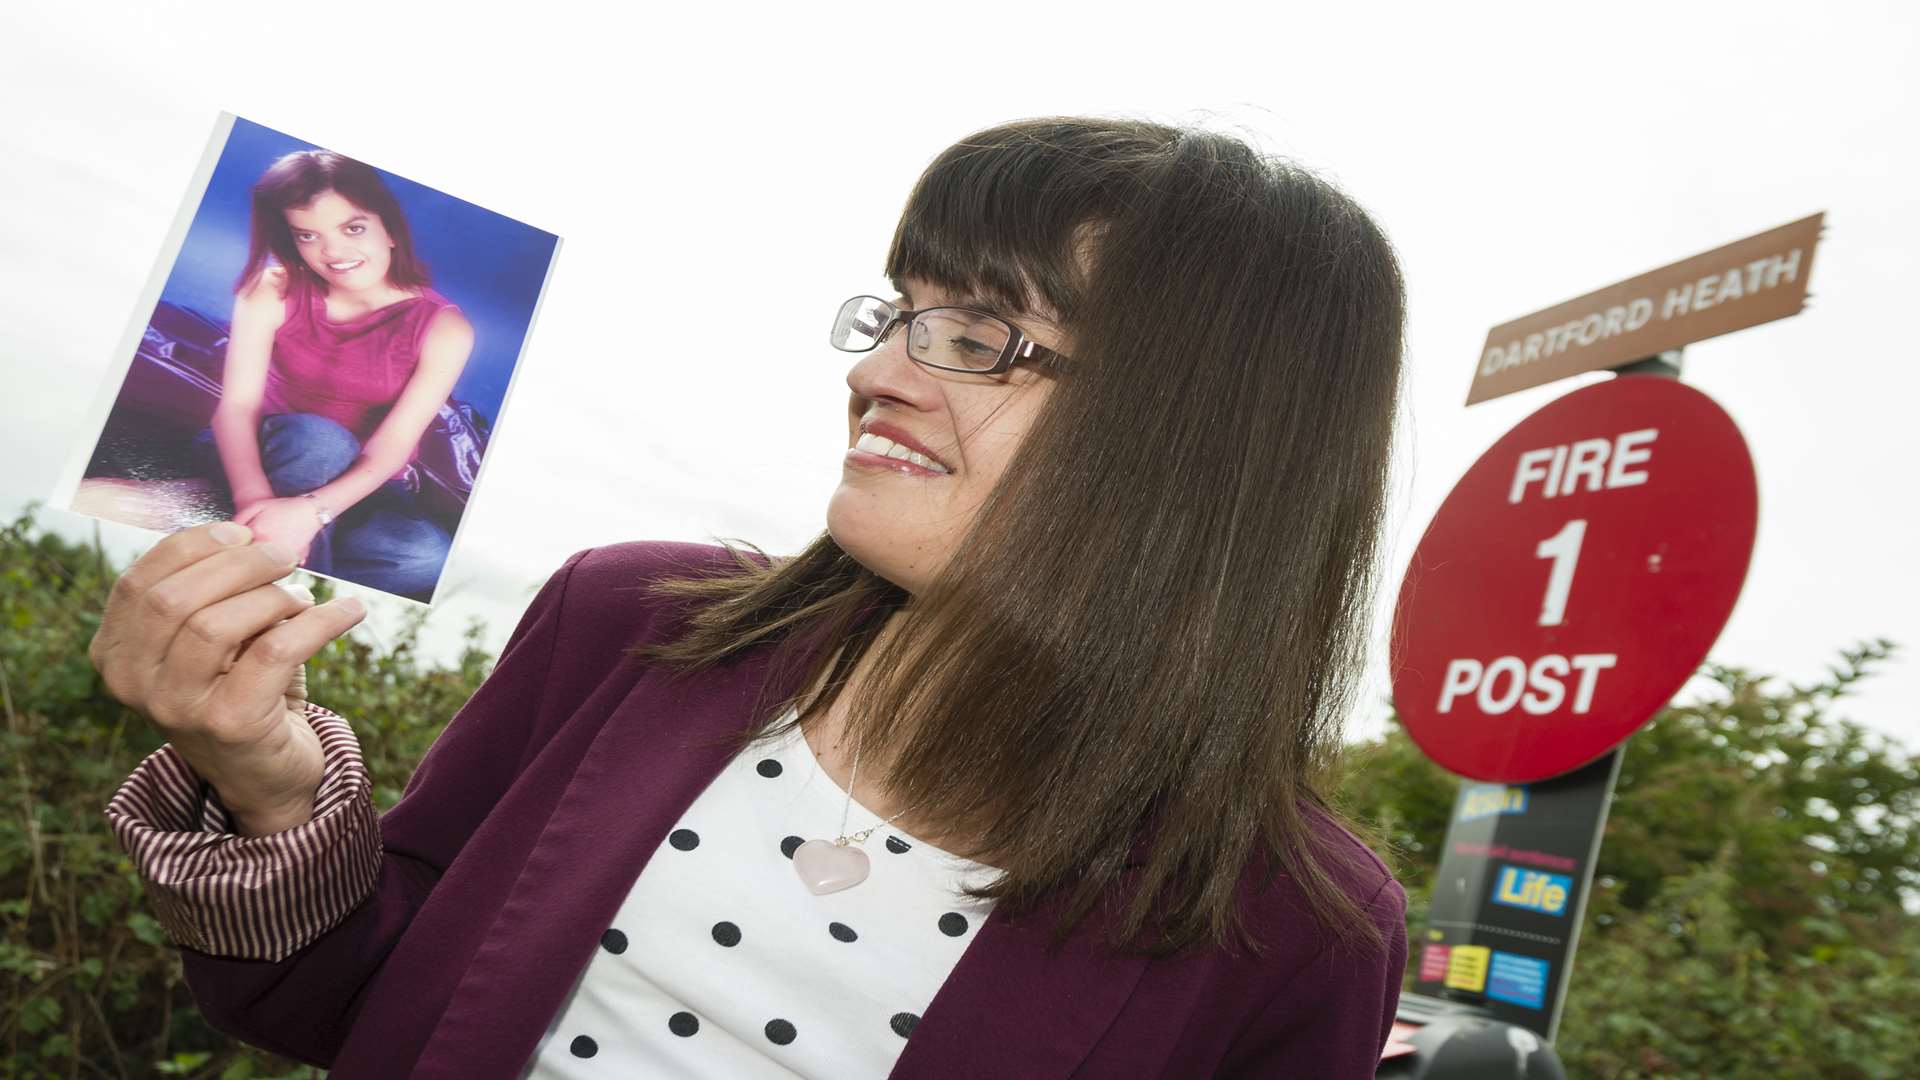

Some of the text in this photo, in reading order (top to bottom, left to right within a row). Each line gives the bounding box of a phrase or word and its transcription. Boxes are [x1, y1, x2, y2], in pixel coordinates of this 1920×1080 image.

[1481, 248, 1801, 376] DARTFORD HEATH
[1508, 429, 1659, 504] FIRE
[1534, 518, 1588, 627] 1
[1437, 653, 1617, 716] POST
[1500, 868, 1566, 912] Life
